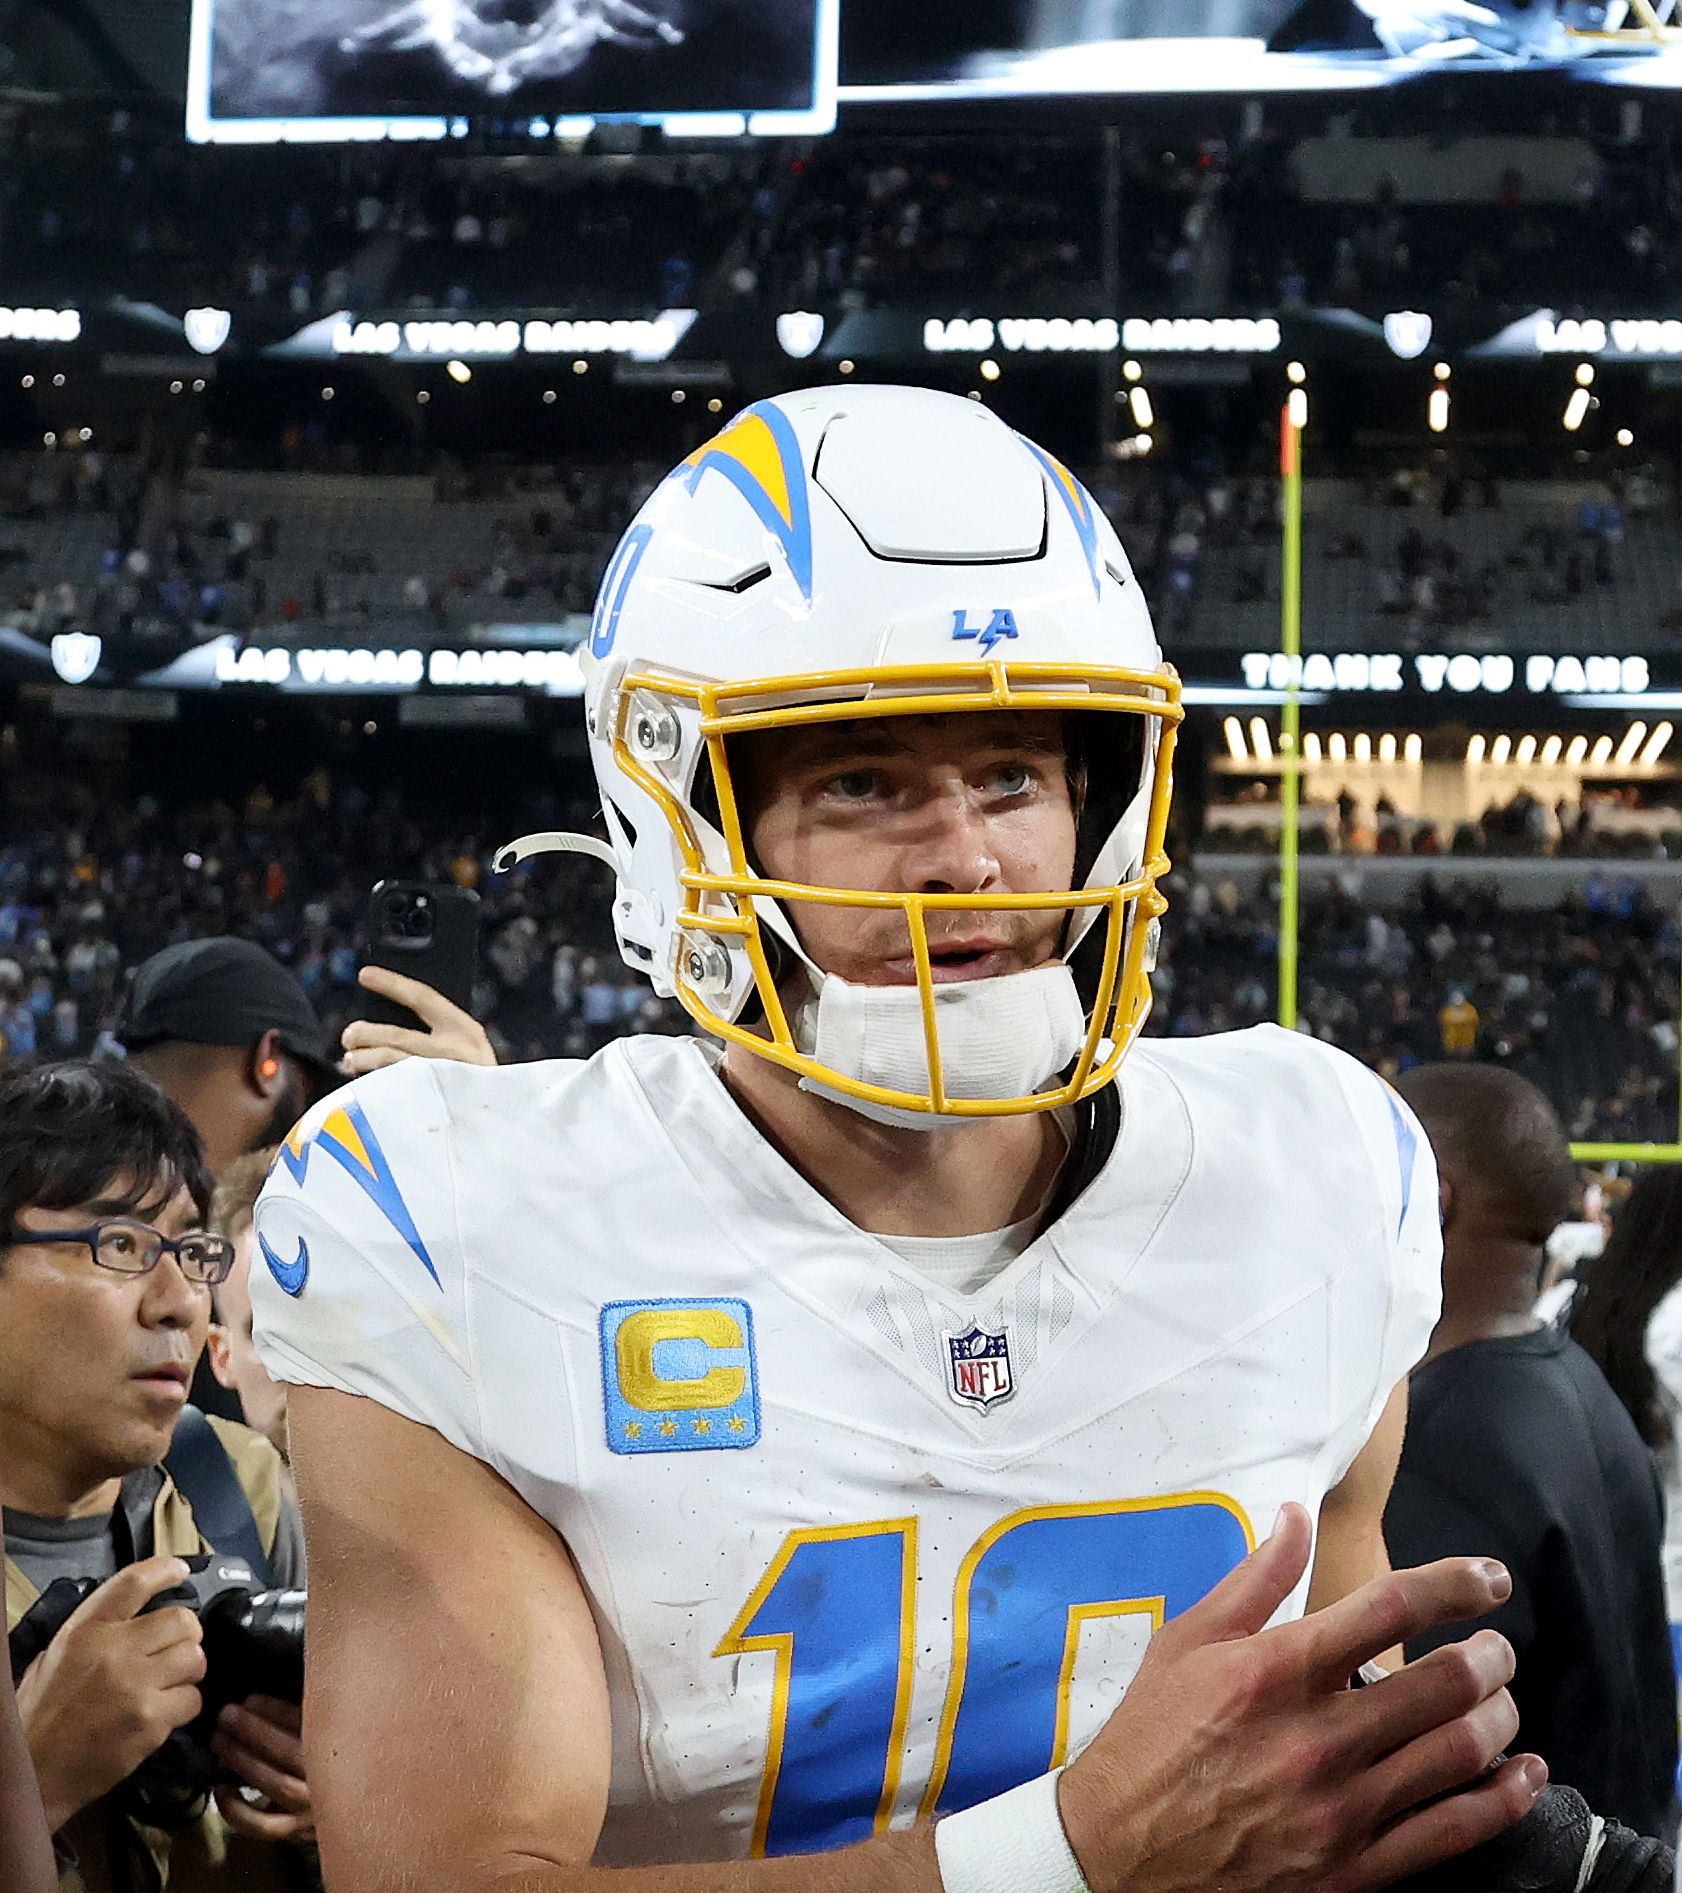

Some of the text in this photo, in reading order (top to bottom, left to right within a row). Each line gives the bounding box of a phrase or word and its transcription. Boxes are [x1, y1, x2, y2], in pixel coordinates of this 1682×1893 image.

[333, 320, 676, 352] LAS VEGAS RAIDERS
[924, 318, 1281, 351] LAS VEGAS RAIDERS
[1536, 319, 1606, 352] LAS
[952, 609, 1019, 657] LA
[216, 648, 291, 682] LAS
[297, 648, 424, 683] VEGAS
[1241, 653, 1650, 692] THANK YOU FANS
[616, 1310, 747, 1411] C
[958, 1361, 1007, 1397] NFL
